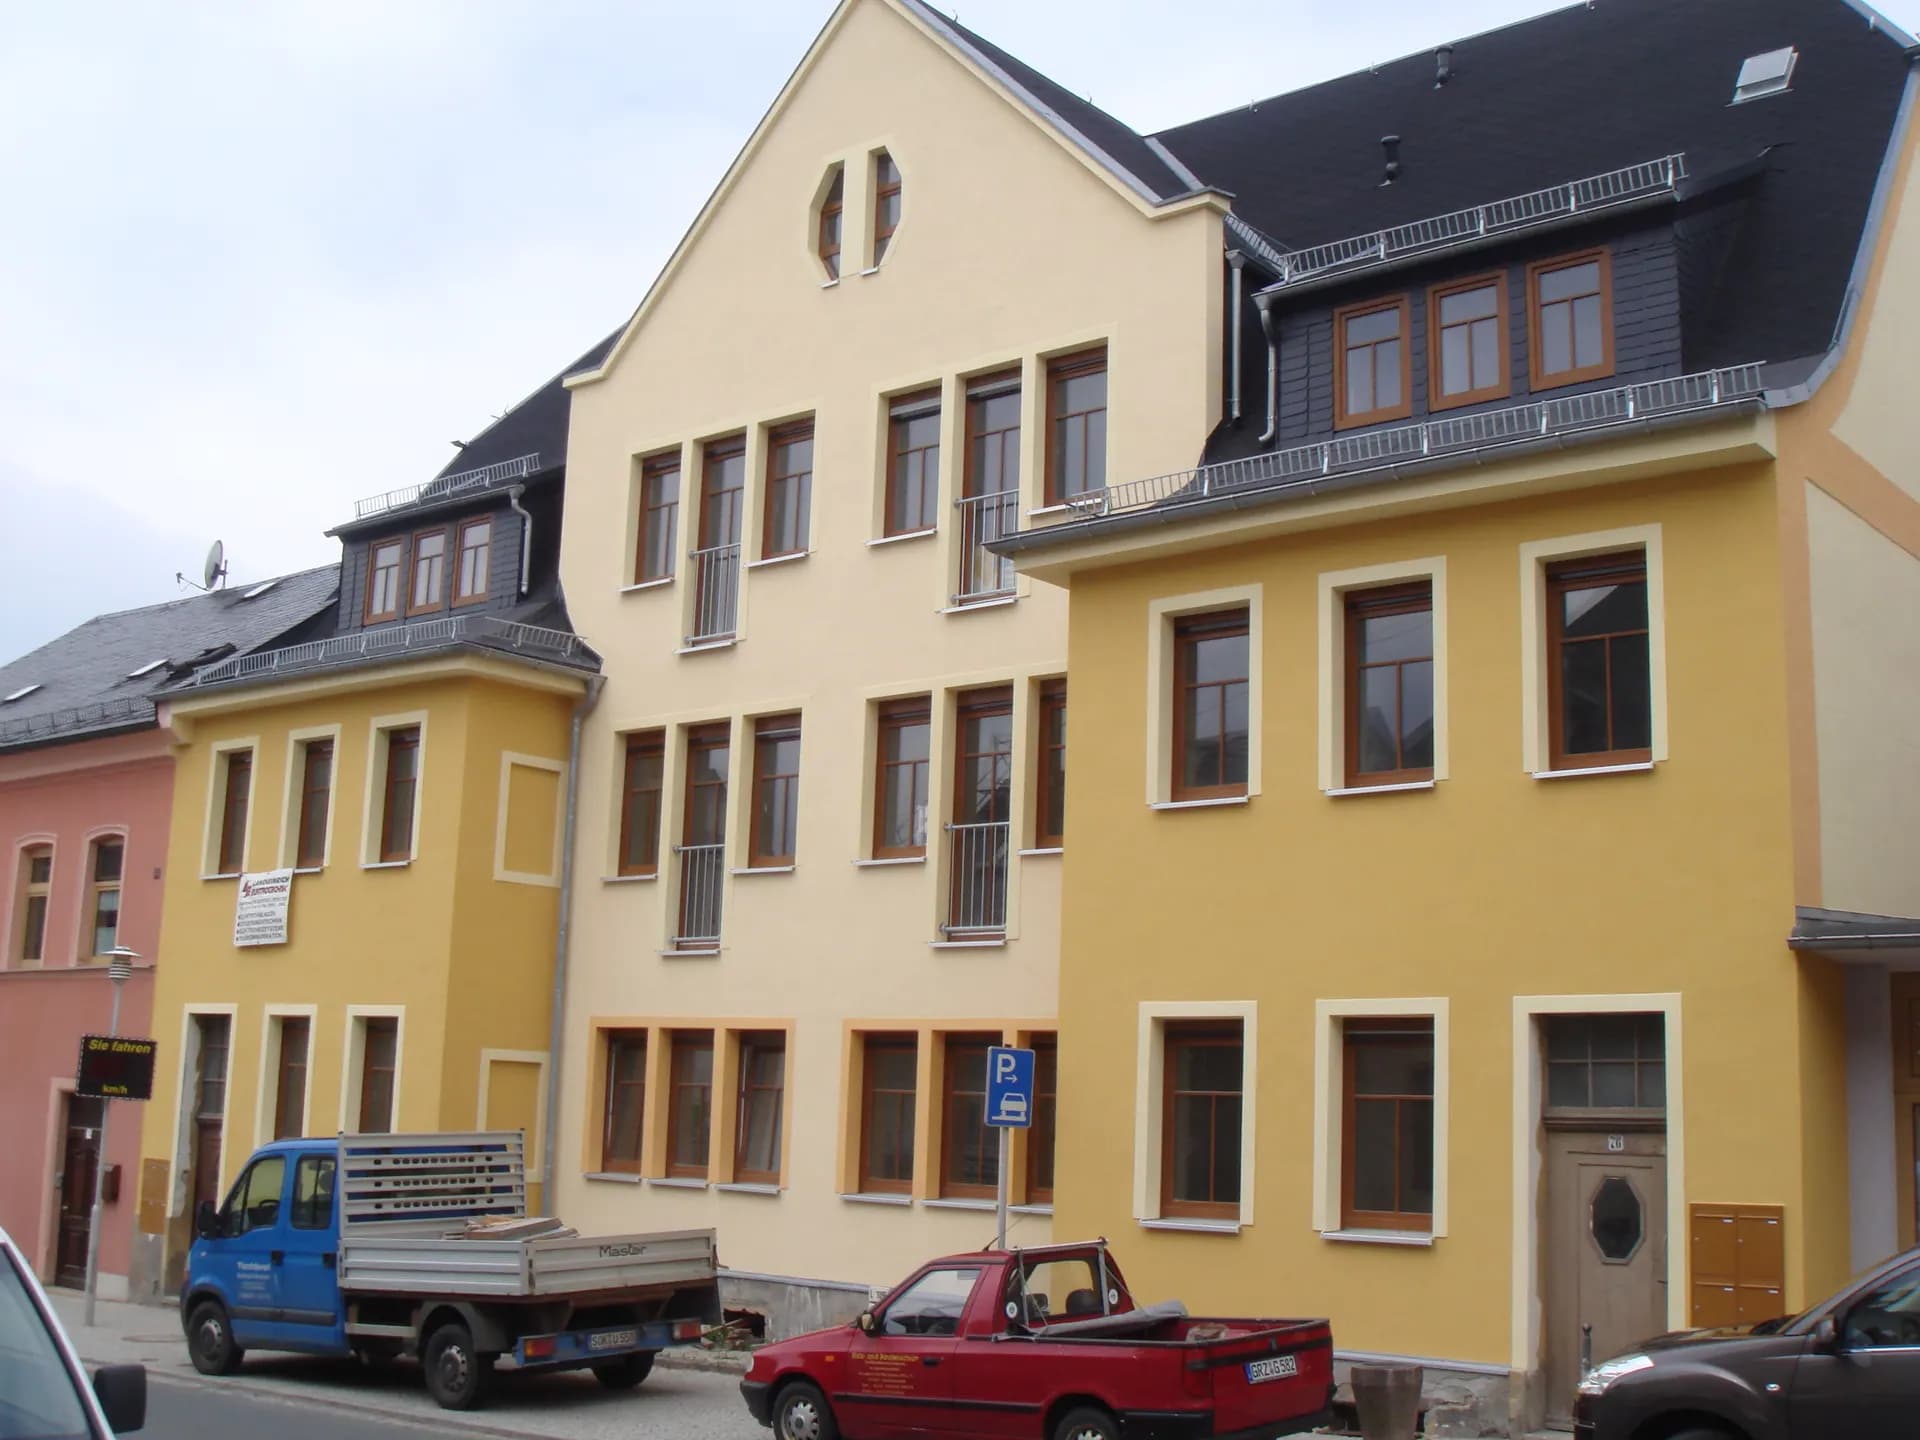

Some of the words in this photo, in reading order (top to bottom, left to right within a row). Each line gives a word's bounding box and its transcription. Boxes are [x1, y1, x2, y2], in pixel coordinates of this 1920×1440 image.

[88, 1039, 109, 1051] Sie
[111, 1041, 152, 1054] fahren
[996, 1053, 1016, 1084] P
[102, 1084, 129, 1095] km/h
[599, 1243, 647, 1258] Master
